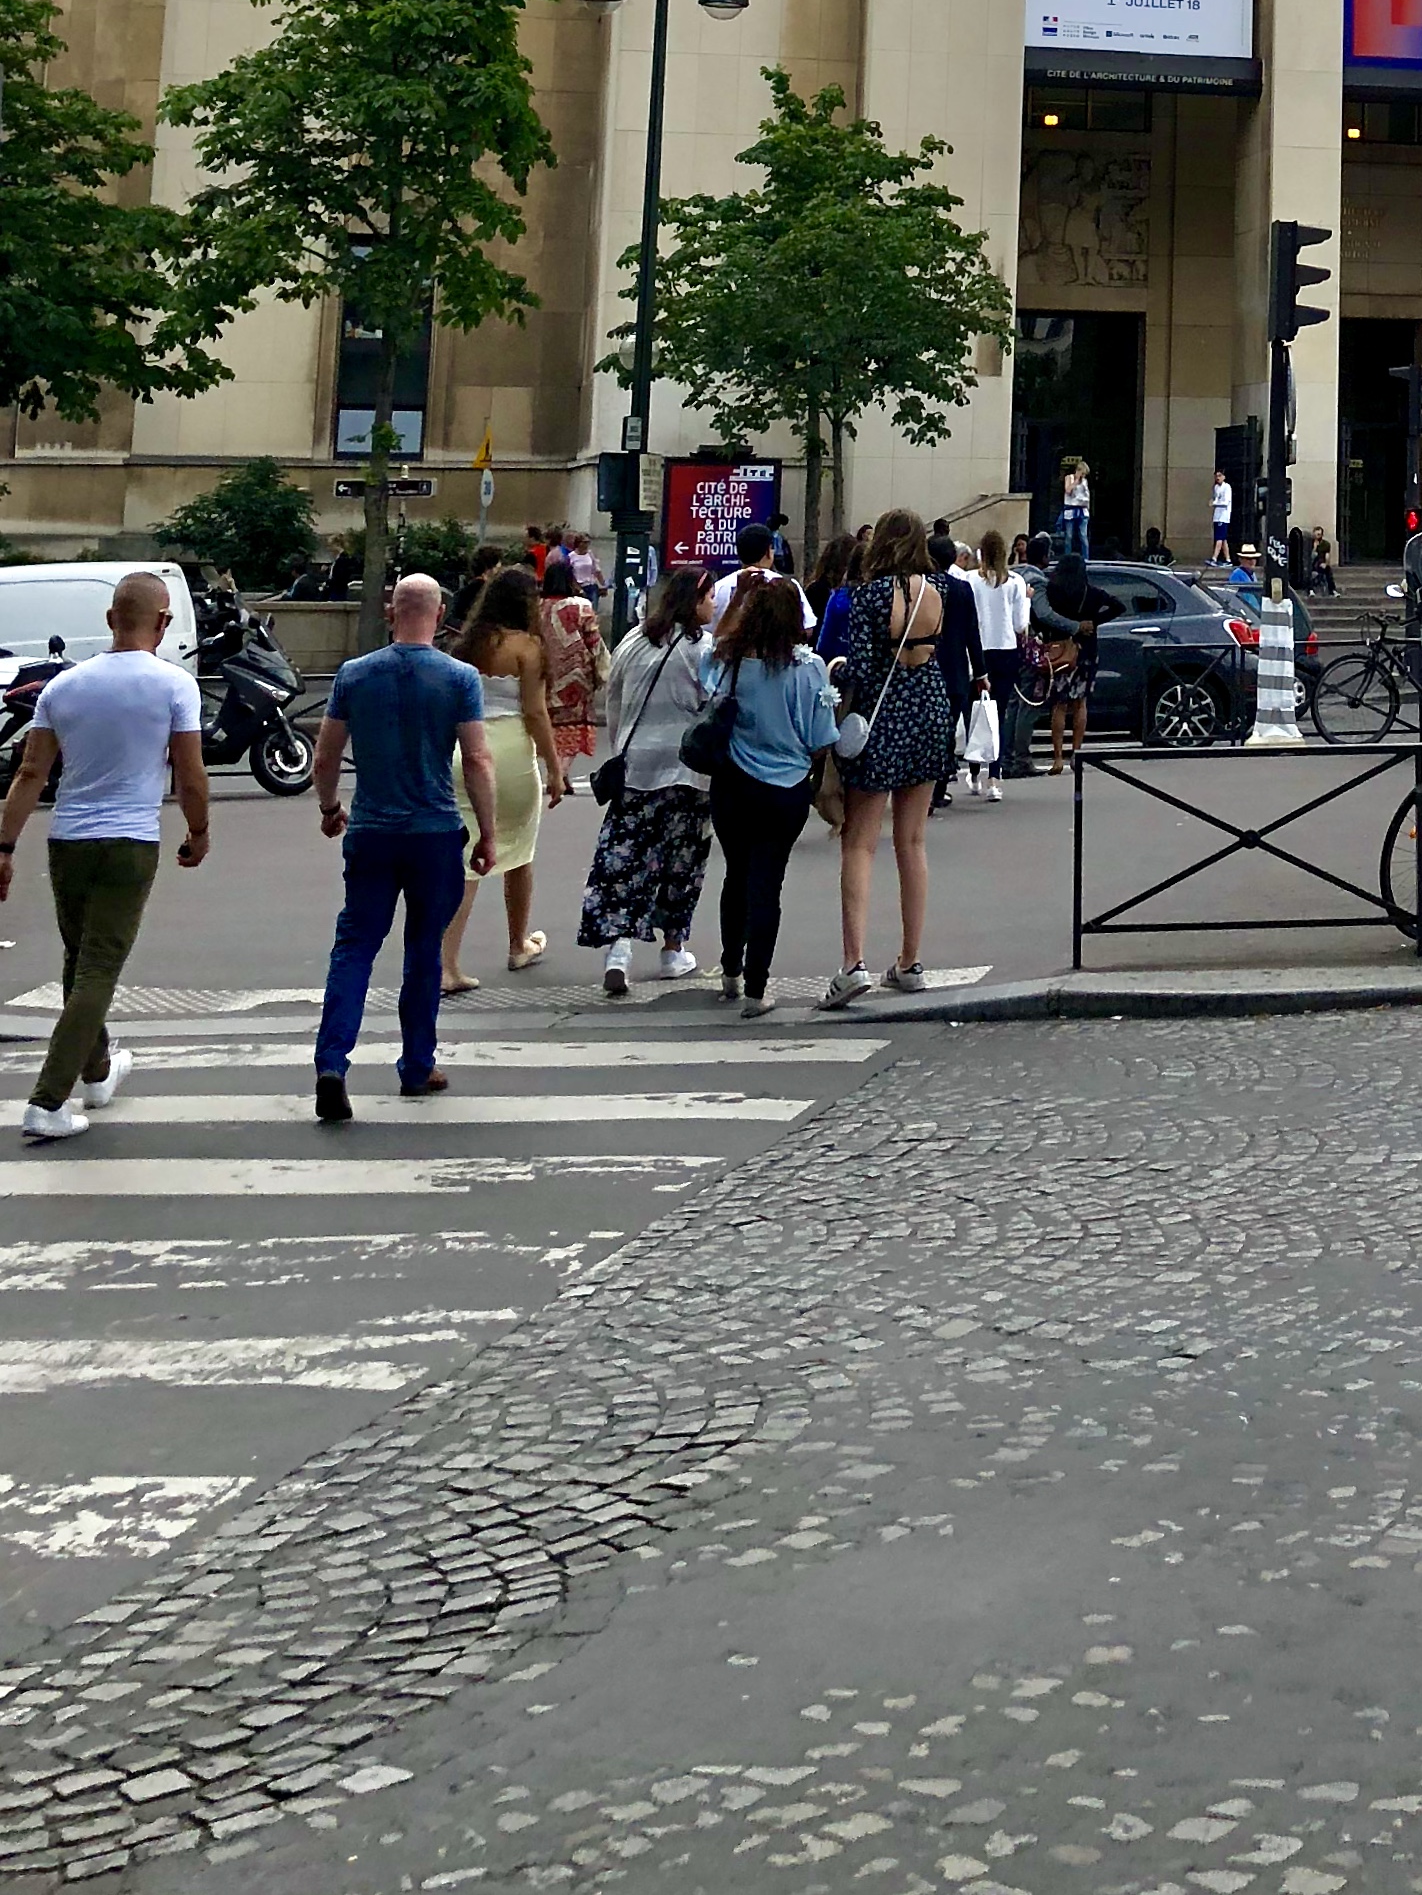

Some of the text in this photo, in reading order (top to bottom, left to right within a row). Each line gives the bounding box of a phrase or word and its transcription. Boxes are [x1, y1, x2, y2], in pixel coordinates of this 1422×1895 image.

[1187, 0, 1201, 10] 18
[1069, 71, 1081, 79] DE
[1182, 76, 1233, 86] PATRIMOINE
[704, 518, 737, 531] & DU
